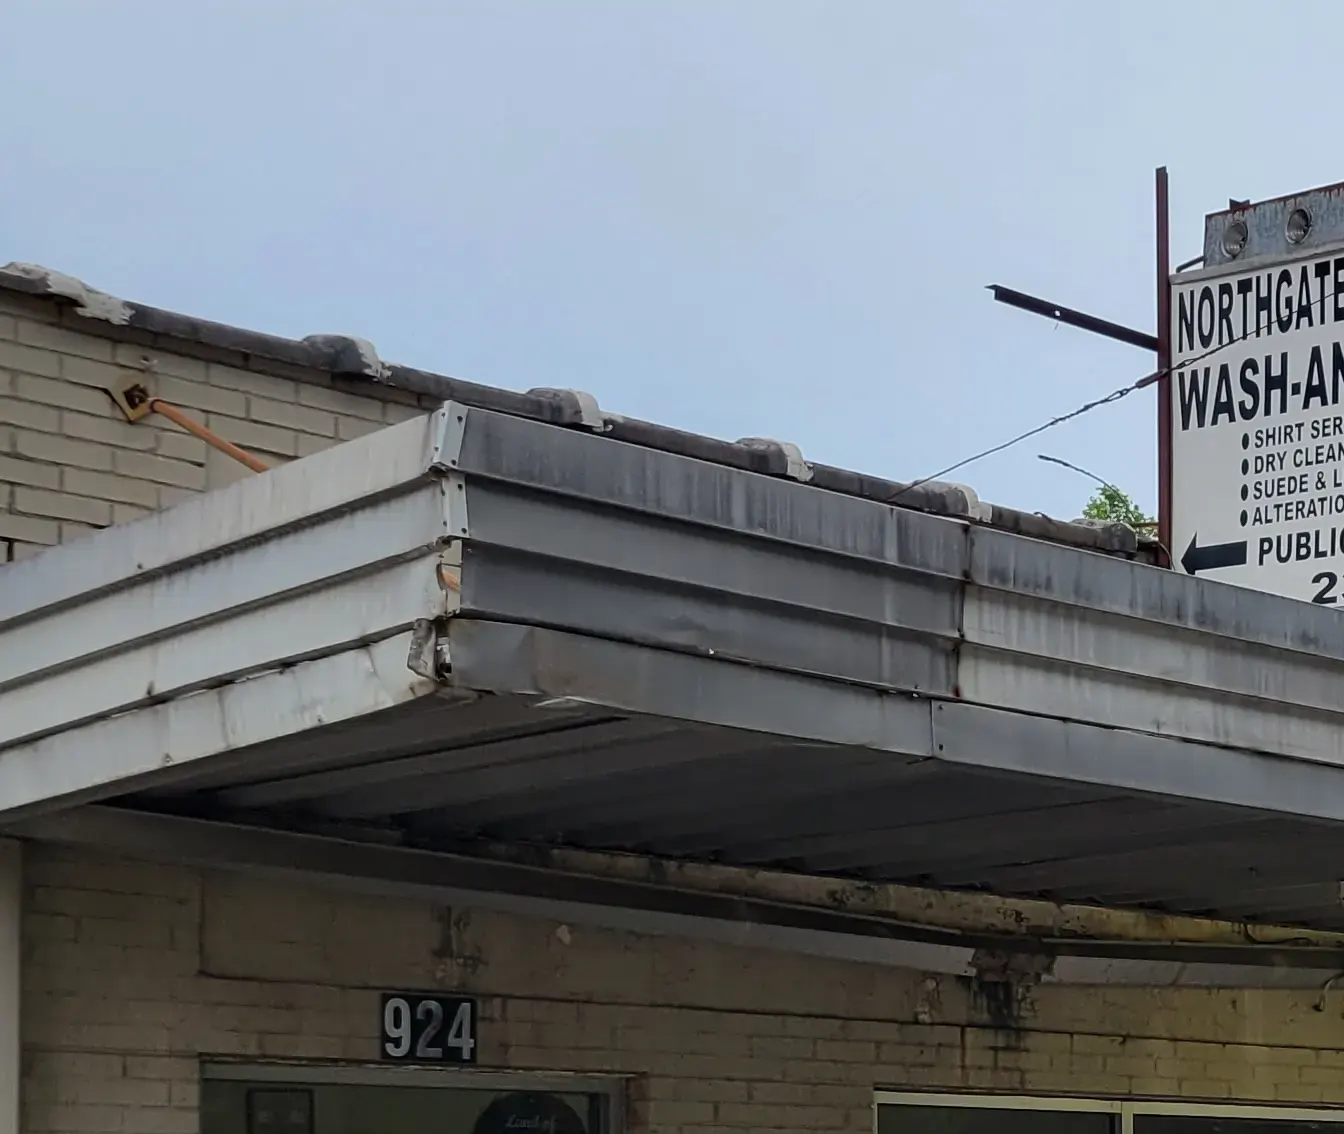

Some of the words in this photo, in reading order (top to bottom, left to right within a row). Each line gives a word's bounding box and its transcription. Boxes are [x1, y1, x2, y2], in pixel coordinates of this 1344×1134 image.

[1254, 422, 1305, 449] SHIRT
[1254, 451, 1288, 474] DRY
[1253, 473, 1309, 500] SUEDE
[1315, 471, 1327, 491] &
[383, 997, 475, 1060] 924
